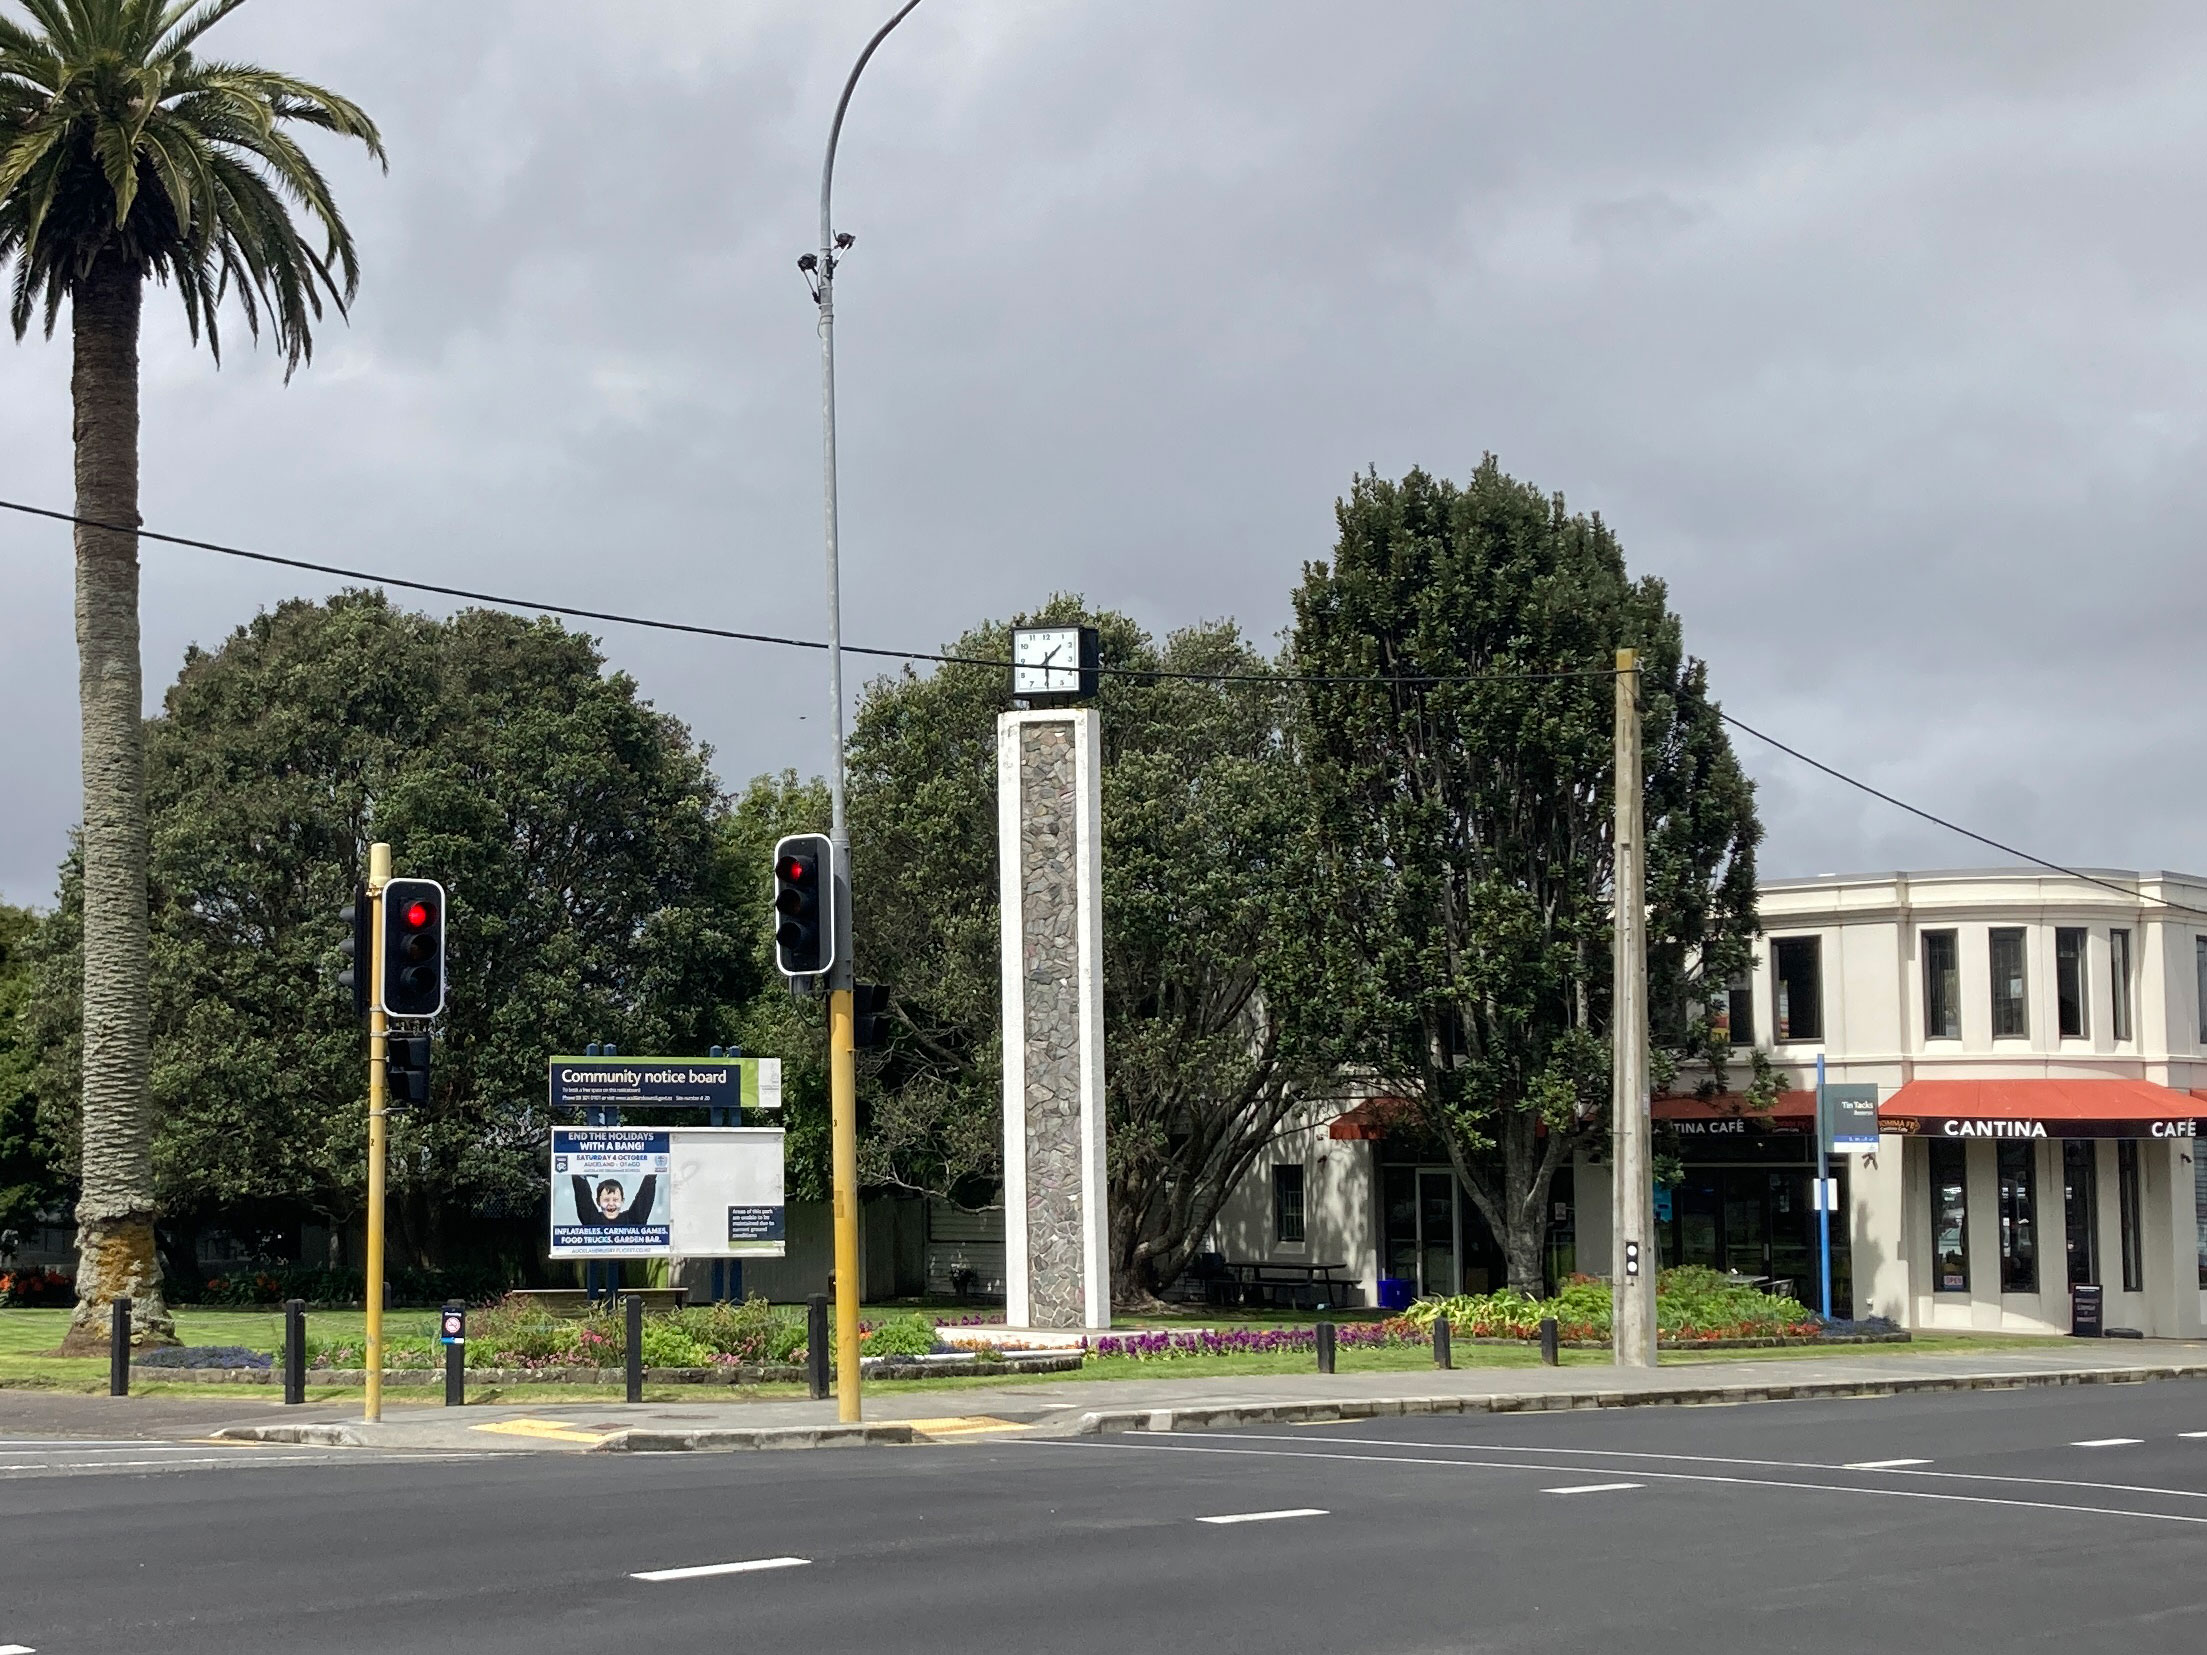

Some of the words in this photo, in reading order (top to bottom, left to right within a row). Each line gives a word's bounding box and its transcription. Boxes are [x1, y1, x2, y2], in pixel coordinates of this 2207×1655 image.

[561, 1069, 642, 1087] Community
[645, 1069, 686, 1083] notice
[688, 1068, 727, 1084] board
[1841, 1101, 1853, 1109] Tin
[1853, 1100, 1873, 1109] Tacks
[1709, 1119, 1745, 1133] CAFÉ
[1944, 1120, 2047, 1137] CANTINA
[2151, 1117, 2197, 1137] CAFÉ
[568, 1132, 588, 1141] END
[589, 1132, 607, 1141] THE
[608, 1132, 654, 1141] HOLIDAYS
[580, 1141, 605, 1151] WITH
[606, 1142, 614, 1150] A
[615, 1142, 645, 1151] BANG!
[554, 1227, 603, 1235] INFLATABLES.
[604, 1227, 640, 1235] CARNIVAL
[640, 1227, 668, 1235] GAMES.
[561, 1236, 582, 1244] FOOD
[584, 1236, 613, 1244] TRUCKS.
[614, 1236, 644, 1244] GARDEN
[645, 1236, 662, 1244] BAR.
